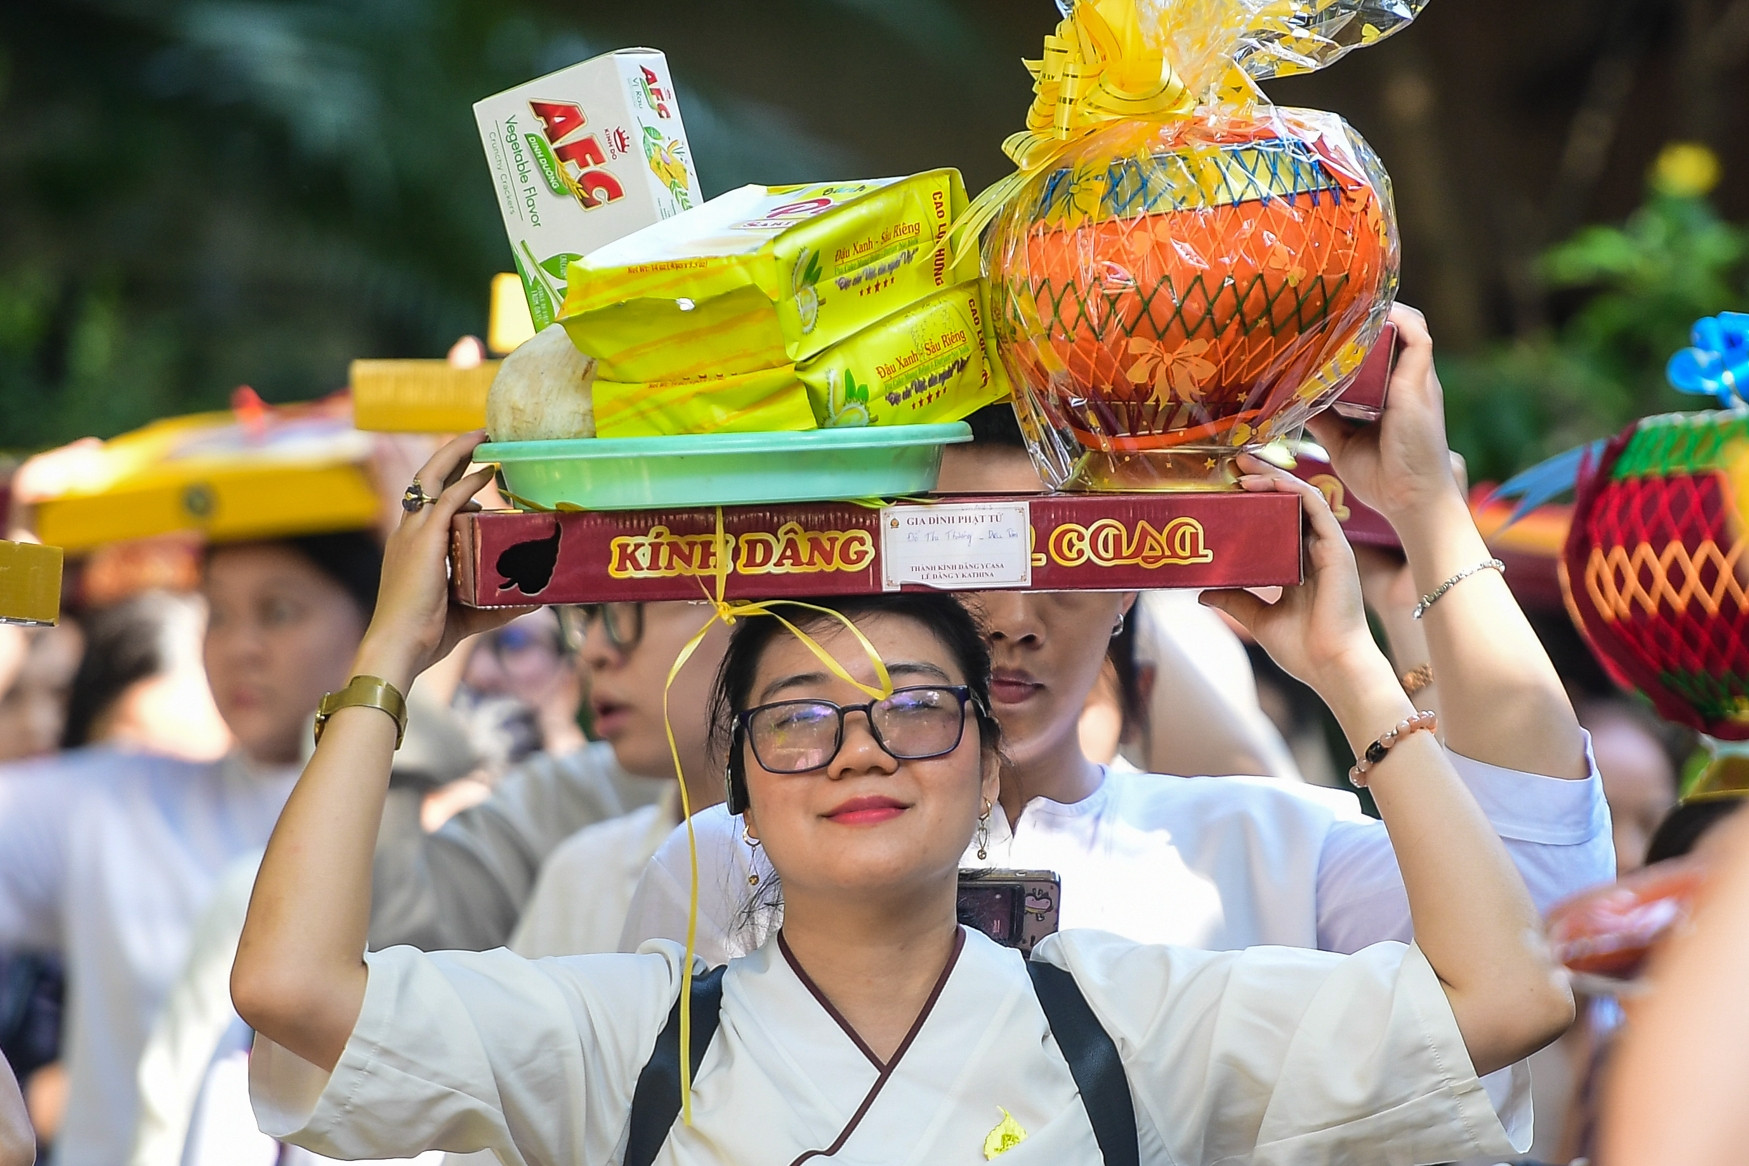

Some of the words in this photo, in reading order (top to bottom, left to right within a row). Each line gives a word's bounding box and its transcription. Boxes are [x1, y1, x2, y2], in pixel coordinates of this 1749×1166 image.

[639, 64, 671, 119] AFC
[489, 131, 503, 171] Crunchy
[500, 173, 515, 215] Crackers
[505, 114, 532, 184] Vegetable
[523, 186, 541, 228] Flavor
[528, 136, 545, 160] DINH
[528, 99, 626, 210] AFC
[932, 191, 945, 219] CAO
[853, 236, 873, 255] Xanh
[893, 222, 920, 238] Riêng
[968, 298, 980, 326] CAO
[875, 363, 897, 380] Đậu
[896, 350, 919, 370] Xanh
[941, 330, 967, 348] Riêng
[907, 517, 926, 526] GIA
[612, 528, 735, 575] KÍNH
[740, 525, 872, 572] DÂNG
